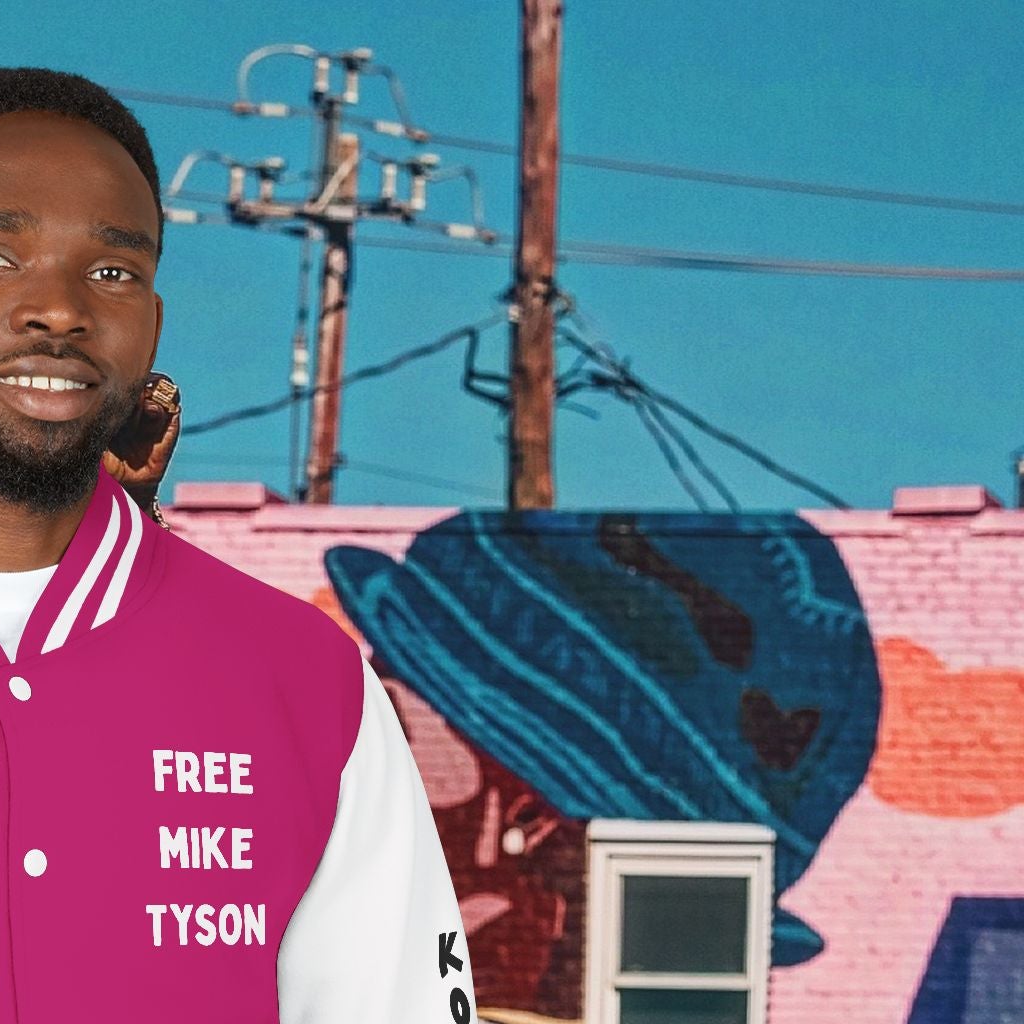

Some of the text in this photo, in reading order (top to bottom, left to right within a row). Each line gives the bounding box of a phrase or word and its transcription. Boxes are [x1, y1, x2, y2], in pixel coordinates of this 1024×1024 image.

[152, 749, 254, 795] FREE
[158, 825, 254, 870] MIKE
[145, 903, 266, 947] TYSON
